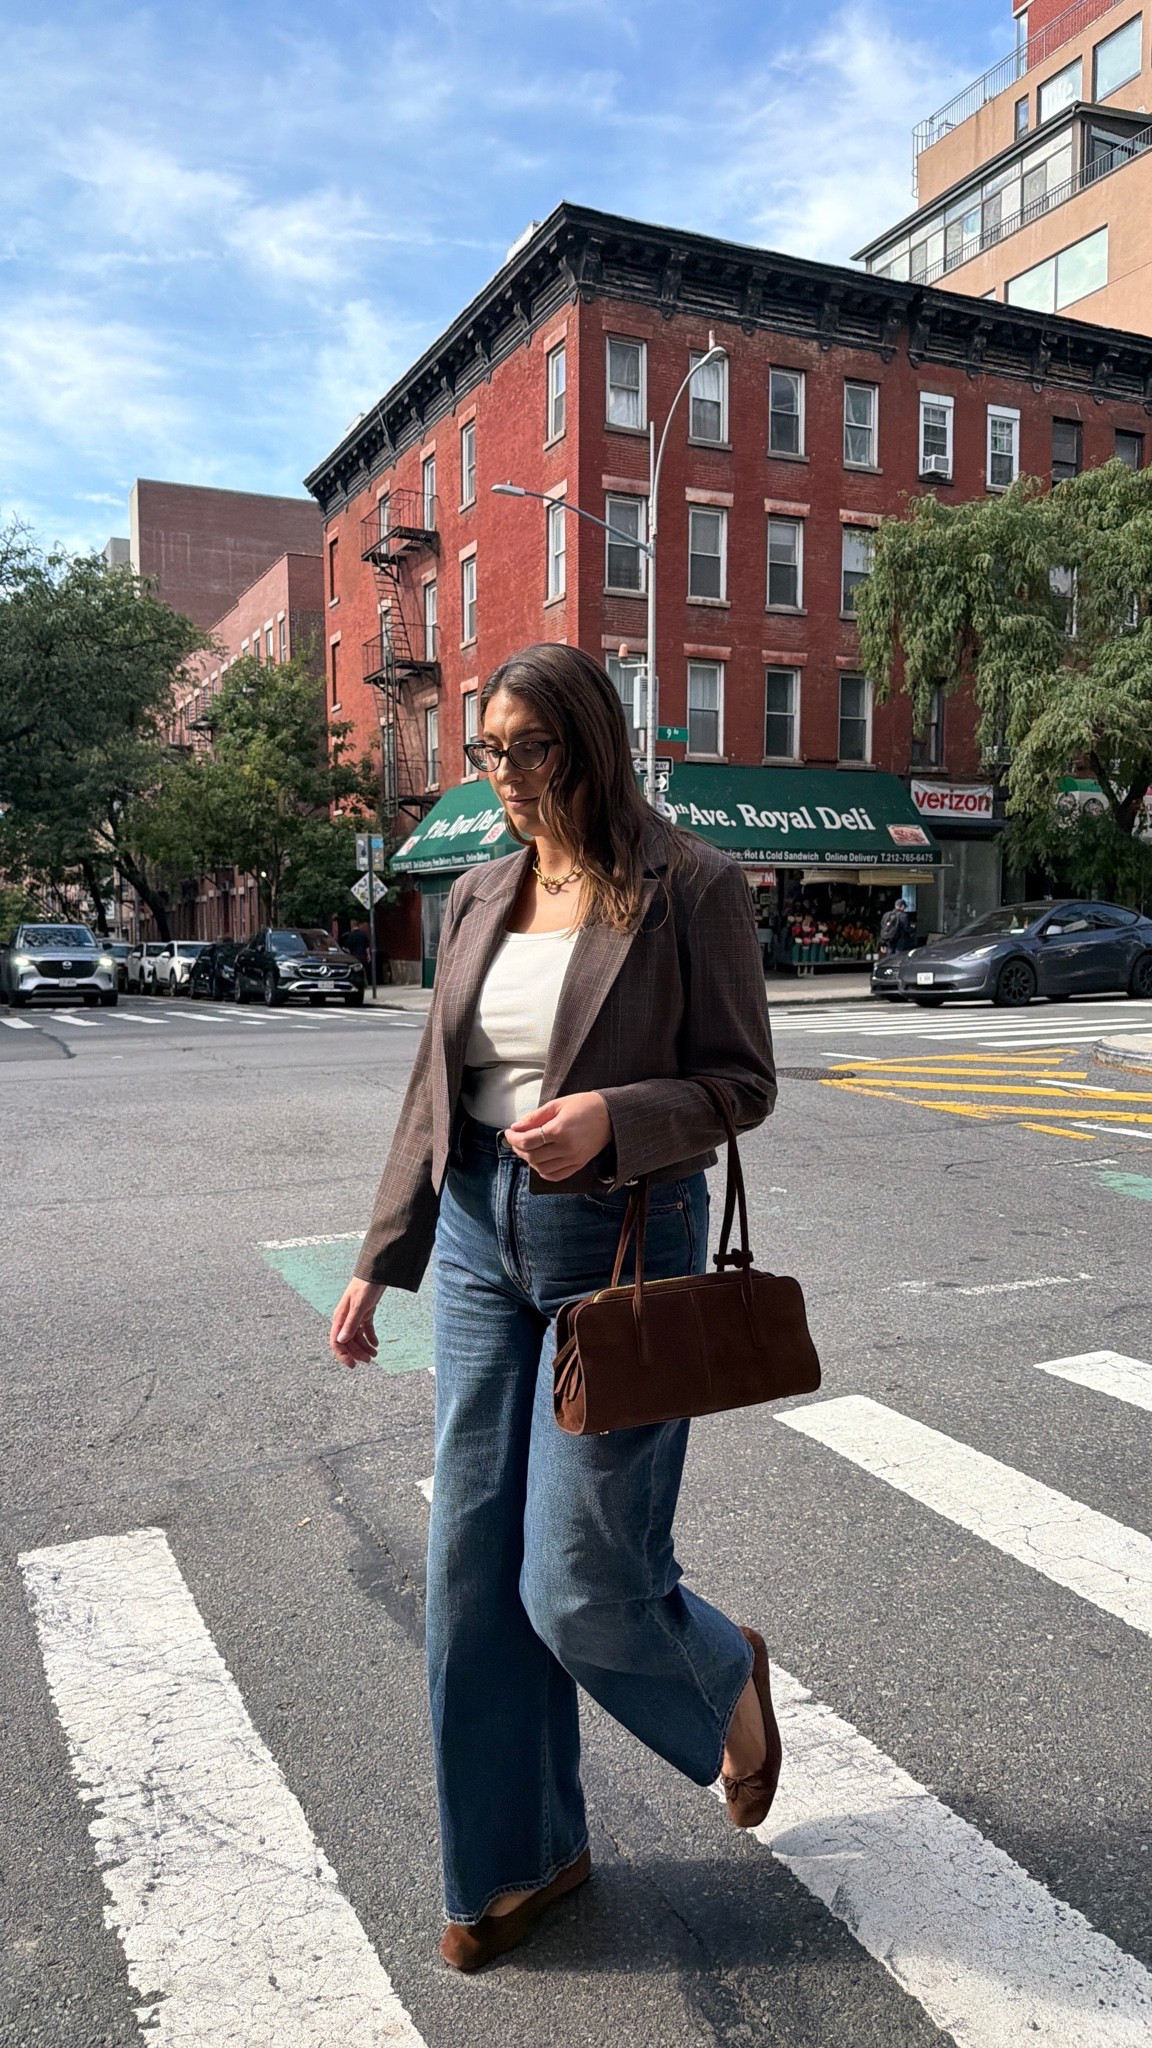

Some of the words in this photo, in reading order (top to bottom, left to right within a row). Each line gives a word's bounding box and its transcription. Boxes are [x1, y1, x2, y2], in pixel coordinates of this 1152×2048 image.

[666, 728, 672, 739] 9
[913, 788, 992, 812] verizon
[689, 802, 737, 827] Ave.
[736, 803, 817, 834] Royal
[815, 806, 876, 831] Deli
[745, 849, 758, 860] Hot
[759, 850, 765, 860] &
[766, 850, 783, 860] Cold
[784, 850, 819, 861] Sandwich
[825, 852, 848, 862] Online
[849, 852, 878, 864] Delivery
